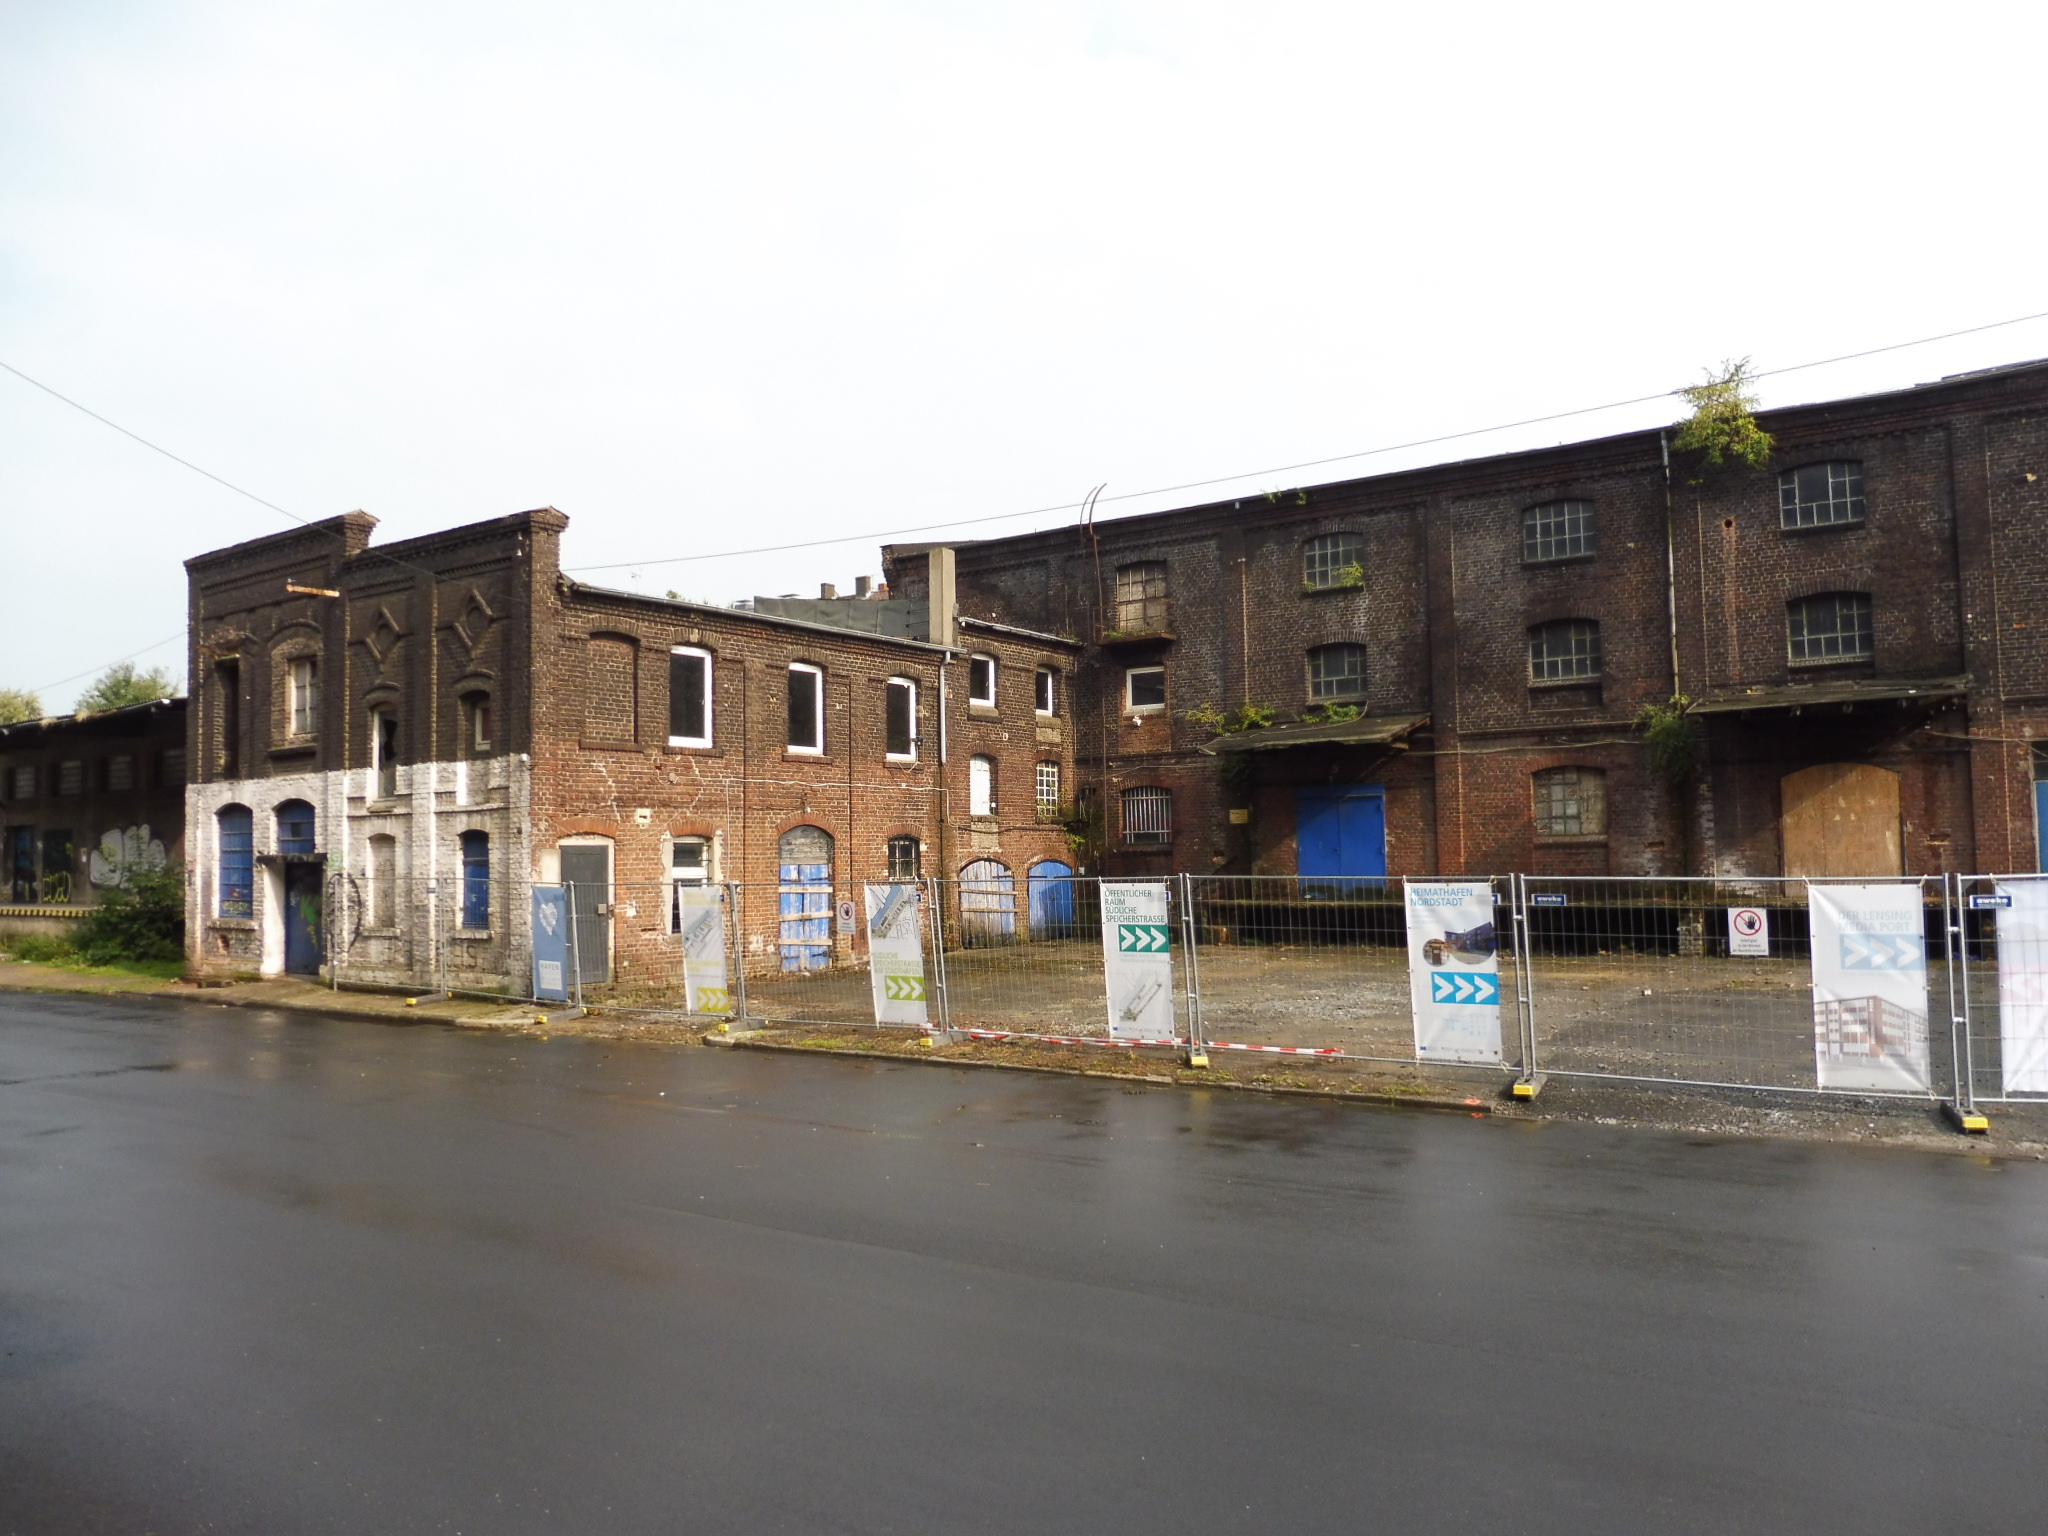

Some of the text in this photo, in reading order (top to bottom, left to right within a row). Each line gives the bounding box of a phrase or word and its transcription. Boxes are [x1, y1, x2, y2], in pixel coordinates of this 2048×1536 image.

[1104, 888, 1152, 898] ÖFFENTLICHER
[1410, 887, 1473, 897] HEIMATHAFEN
[1104, 898, 1126, 906] RAUM
[1410, 897, 1463, 907] NORDSTADT
[1105, 905, 1138, 915] SÜDLICHE
[1105, 914, 1165, 923] SPEICHERSTRASSE
[1838, 910, 1913, 921] DER LENSING
[1880, 921, 1910, 932] PORT
